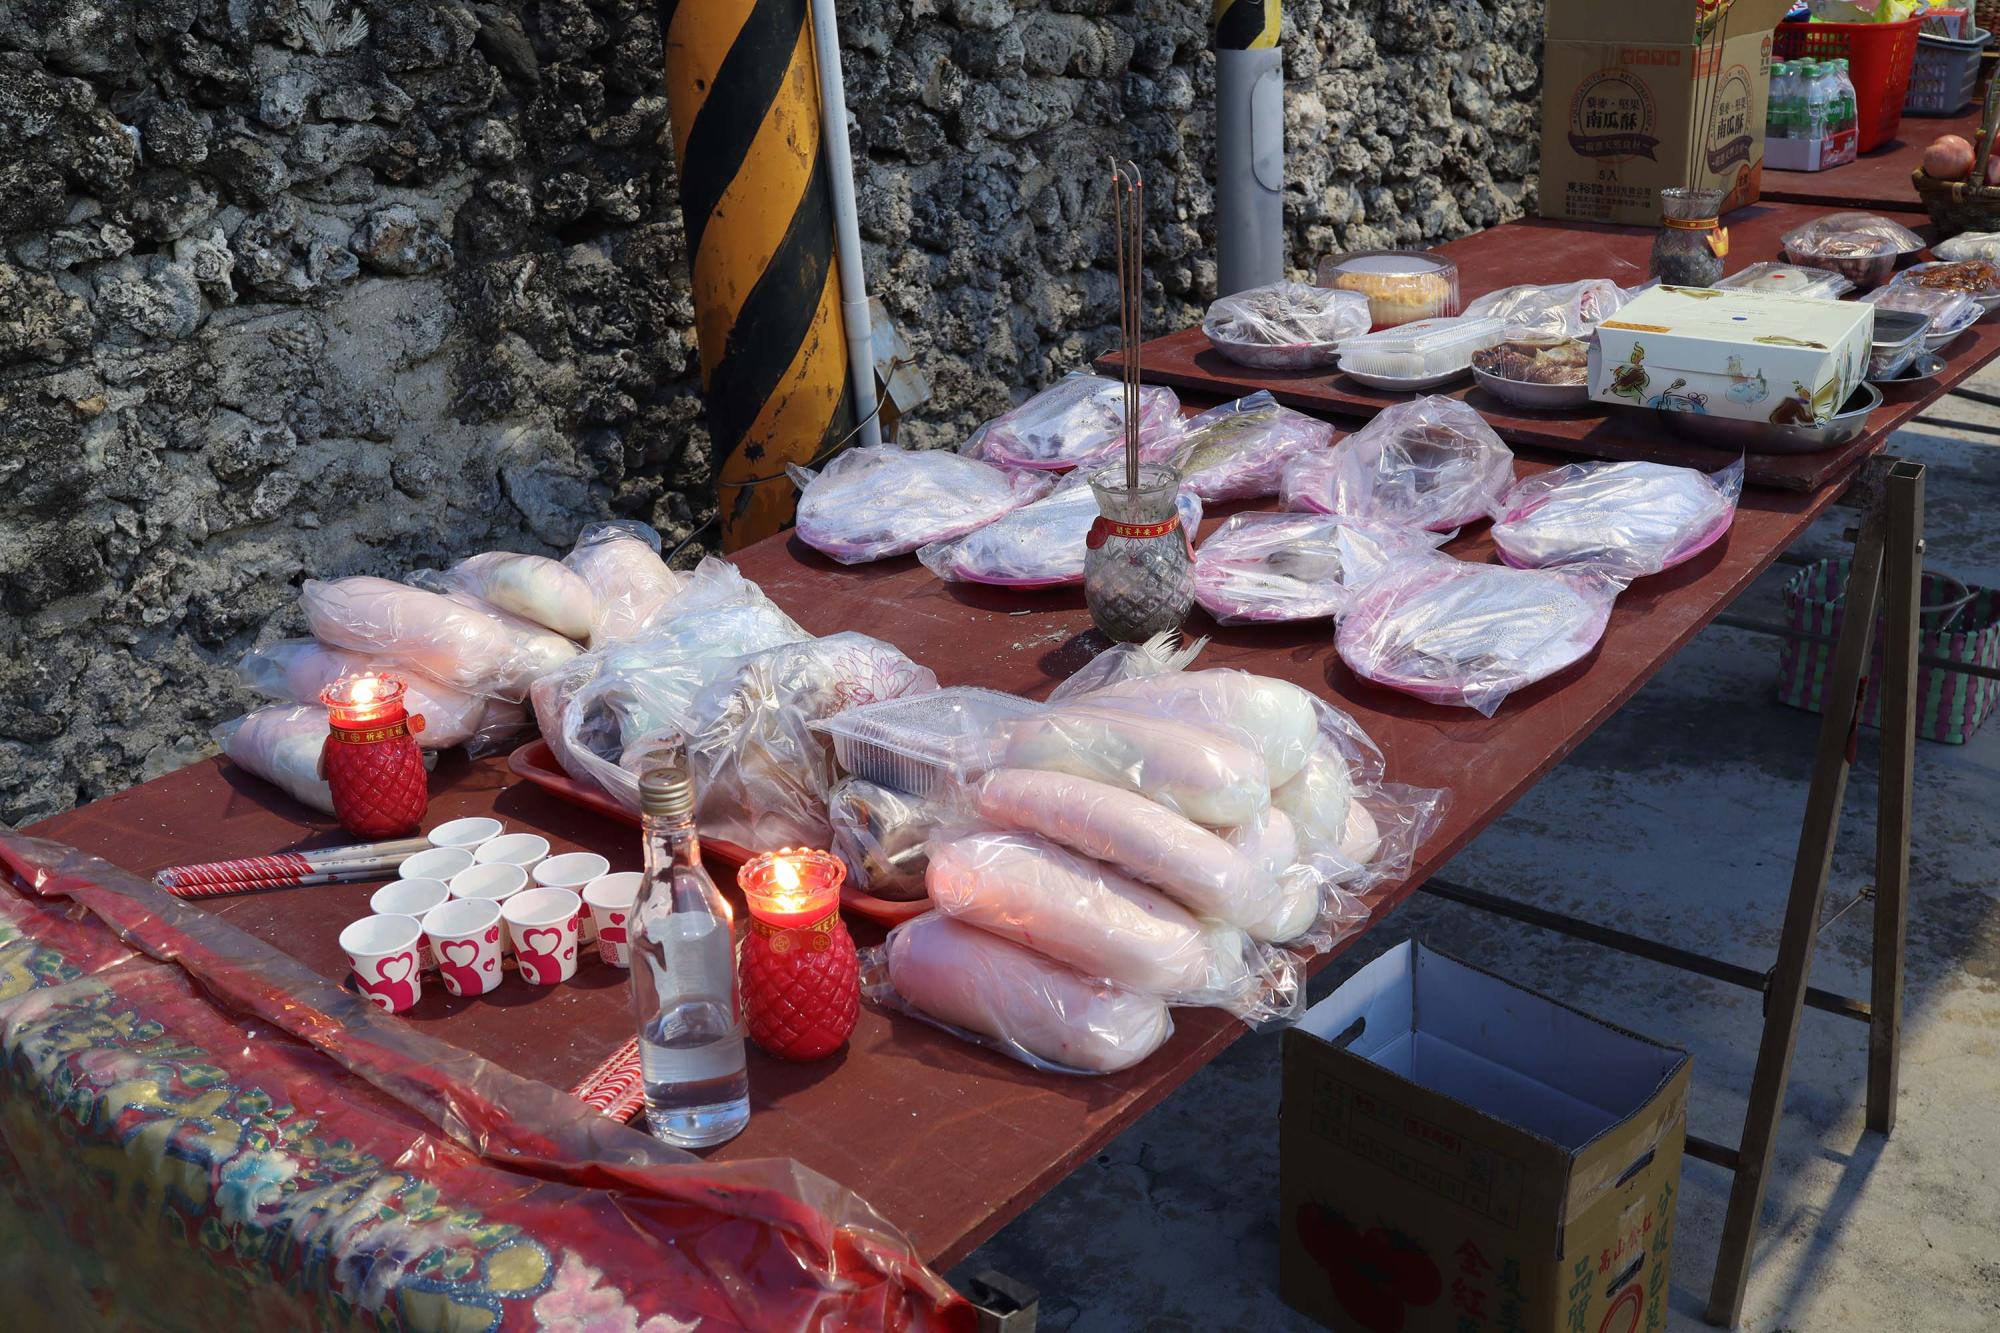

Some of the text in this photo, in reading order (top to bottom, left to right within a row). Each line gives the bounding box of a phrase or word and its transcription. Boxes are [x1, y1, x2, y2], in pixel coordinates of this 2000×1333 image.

[1586, 109, 1637, 131] 南瓜酥
[1717, 113, 1744, 140] 南瓜酥
[1599, 169, 1617, 181] 5入
